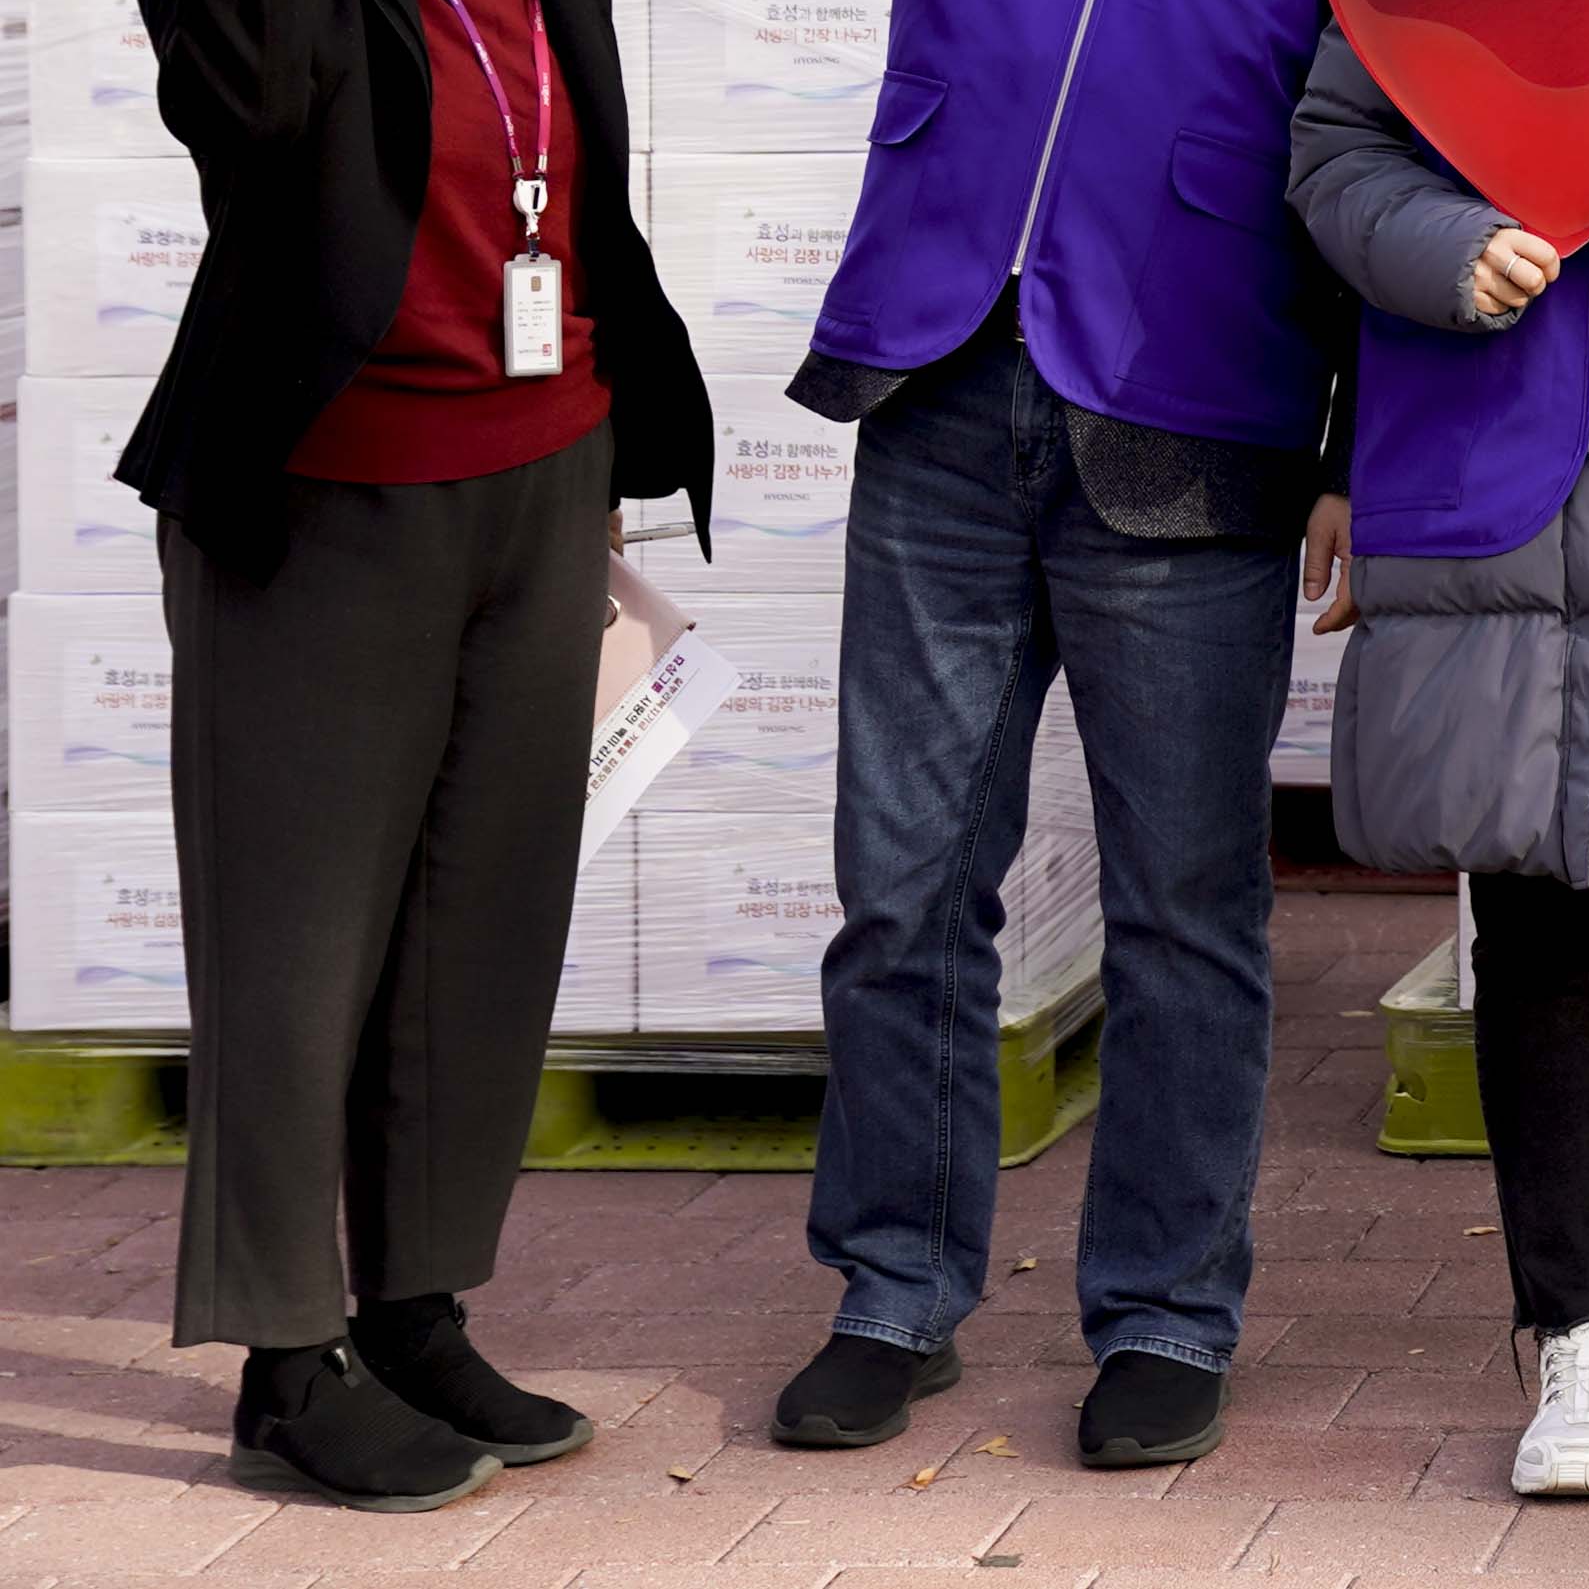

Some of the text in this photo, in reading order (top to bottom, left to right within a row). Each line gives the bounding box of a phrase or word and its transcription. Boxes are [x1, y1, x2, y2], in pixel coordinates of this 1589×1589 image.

[807, 228, 849, 243] 함께하
[793, 247, 822, 264] 김장
[736, 440, 838, 459] 효성과 함께하는
[726, 463, 848, 480] 사랑의 김장 나누기
